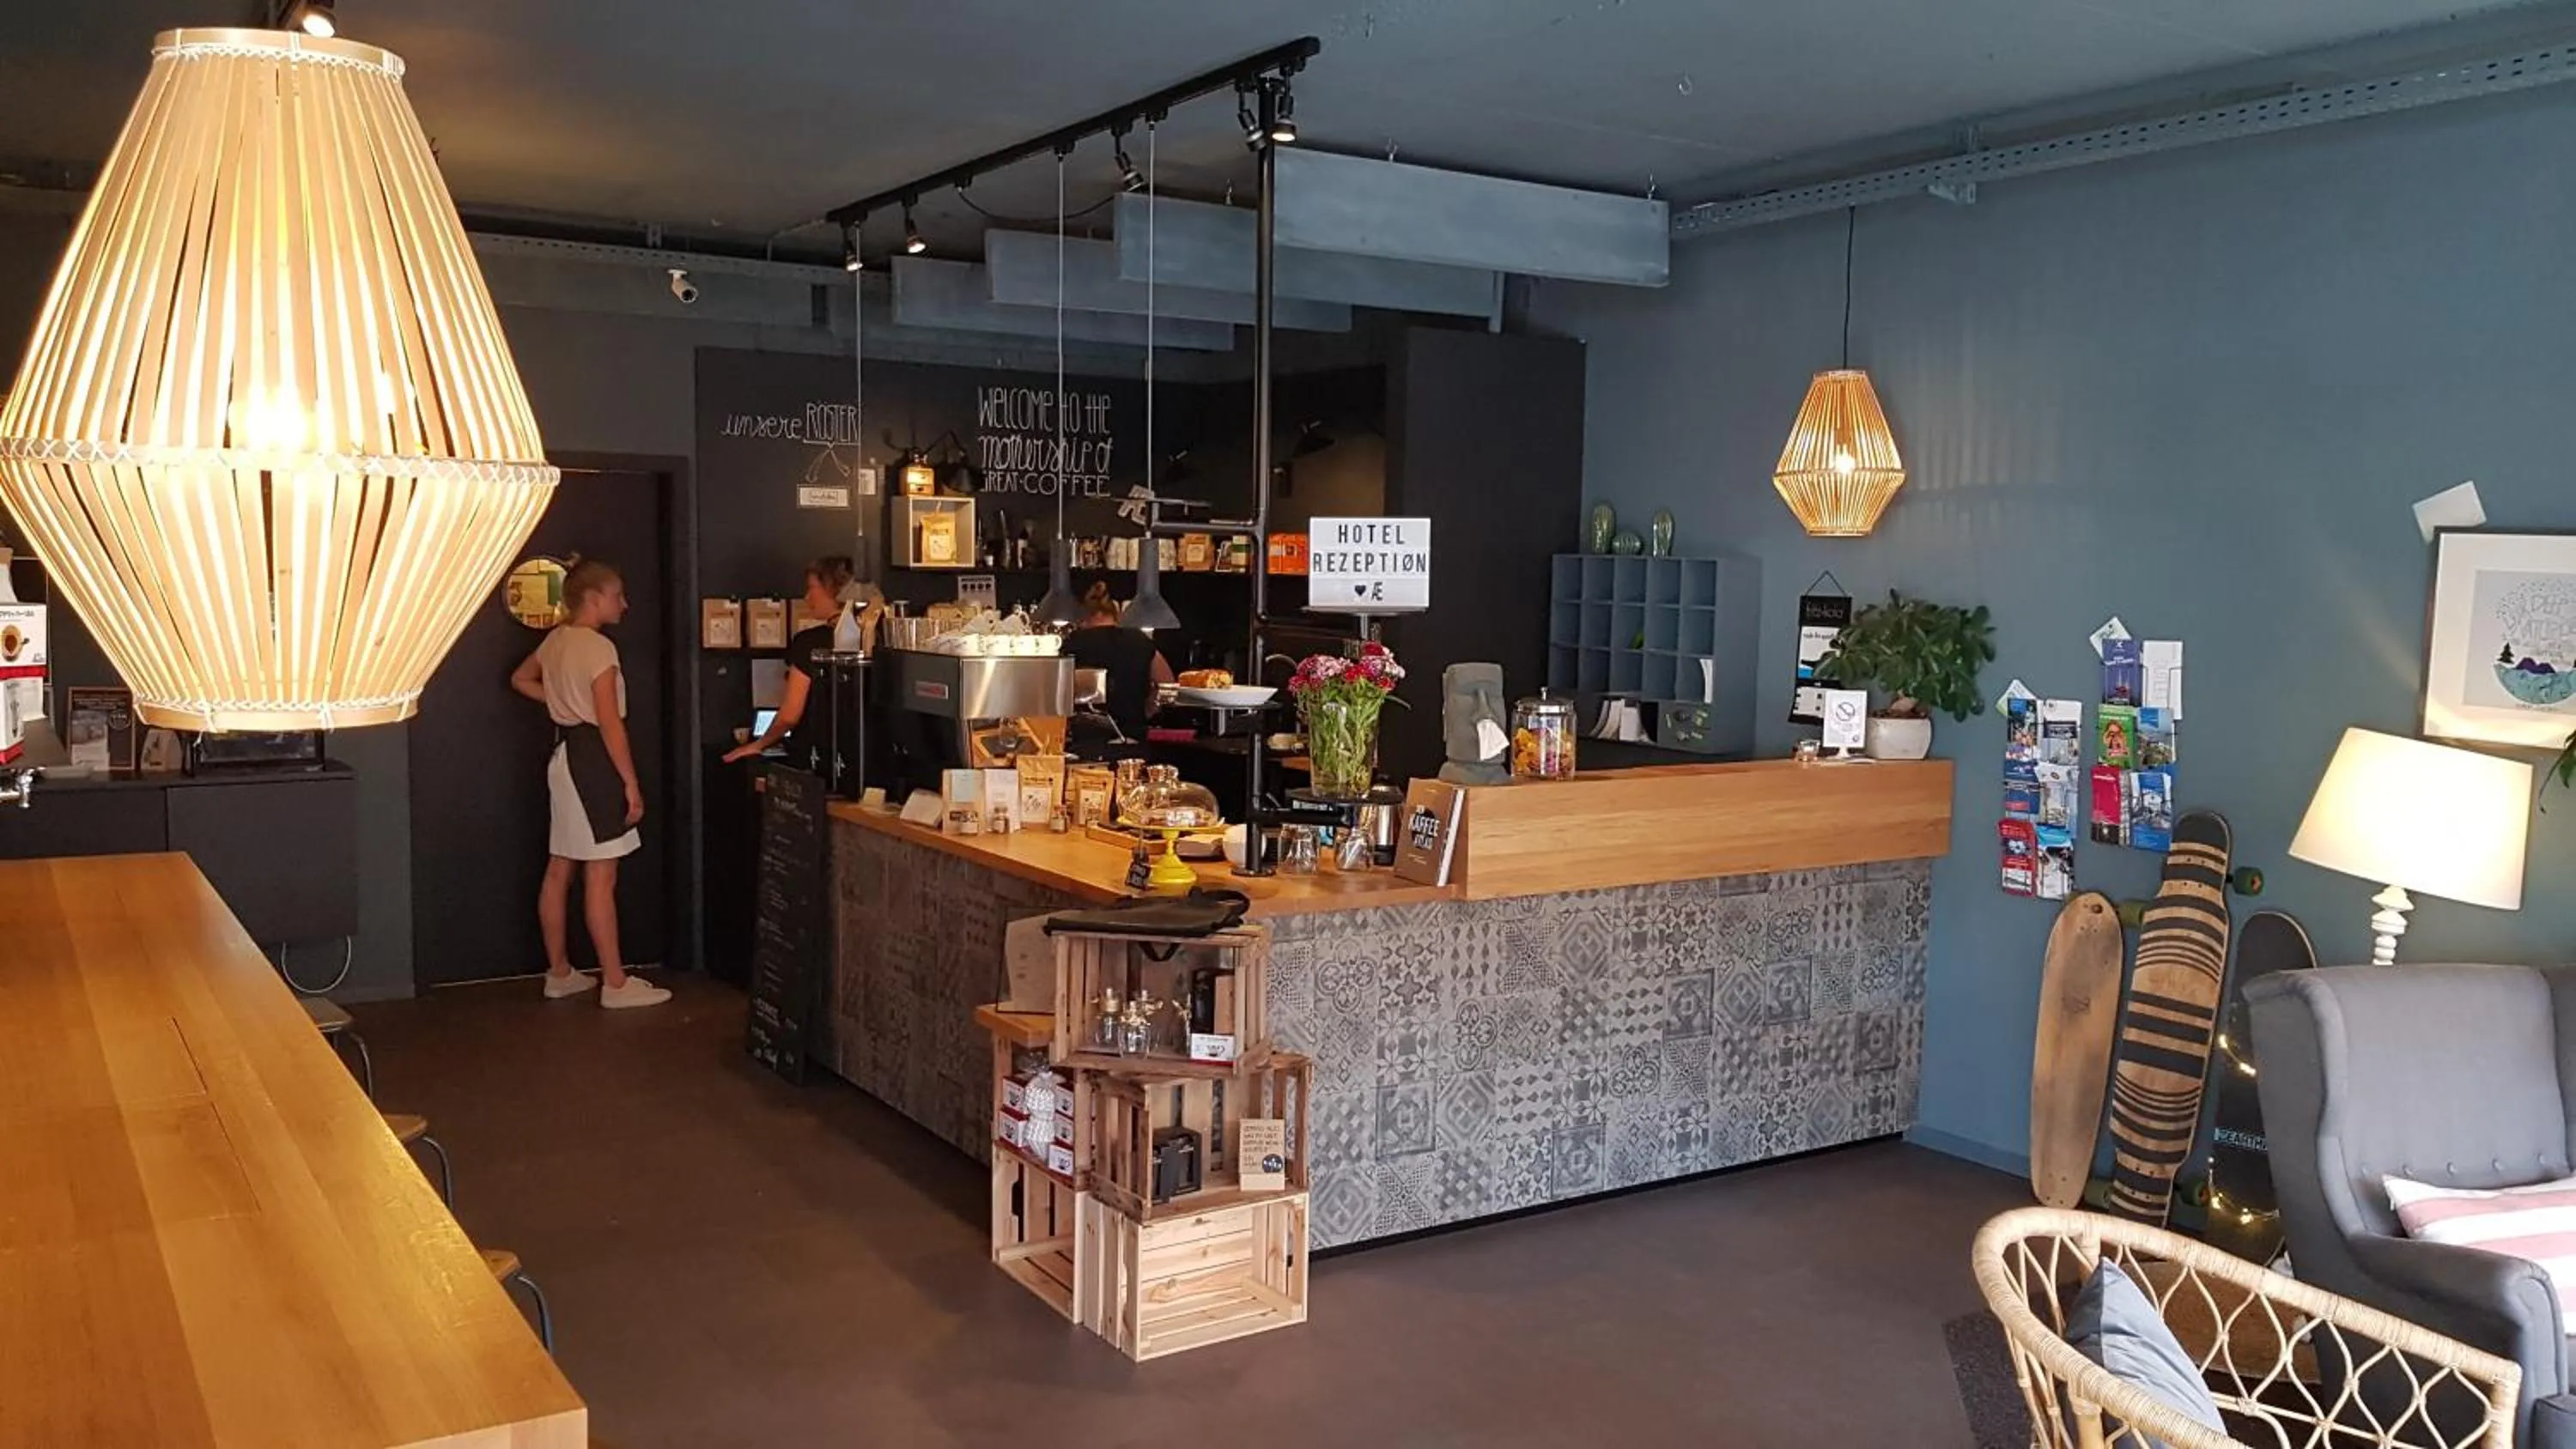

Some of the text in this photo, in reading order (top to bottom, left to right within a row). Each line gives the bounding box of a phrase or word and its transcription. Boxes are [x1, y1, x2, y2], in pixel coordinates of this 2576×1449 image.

[720, 414, 804, 440] unsere
[1338, 524, 1406, 545] HOTEL
[1312, 552, 1426, 573] REZEPTIØN
[1370, 580, 1383, 602] Æ
